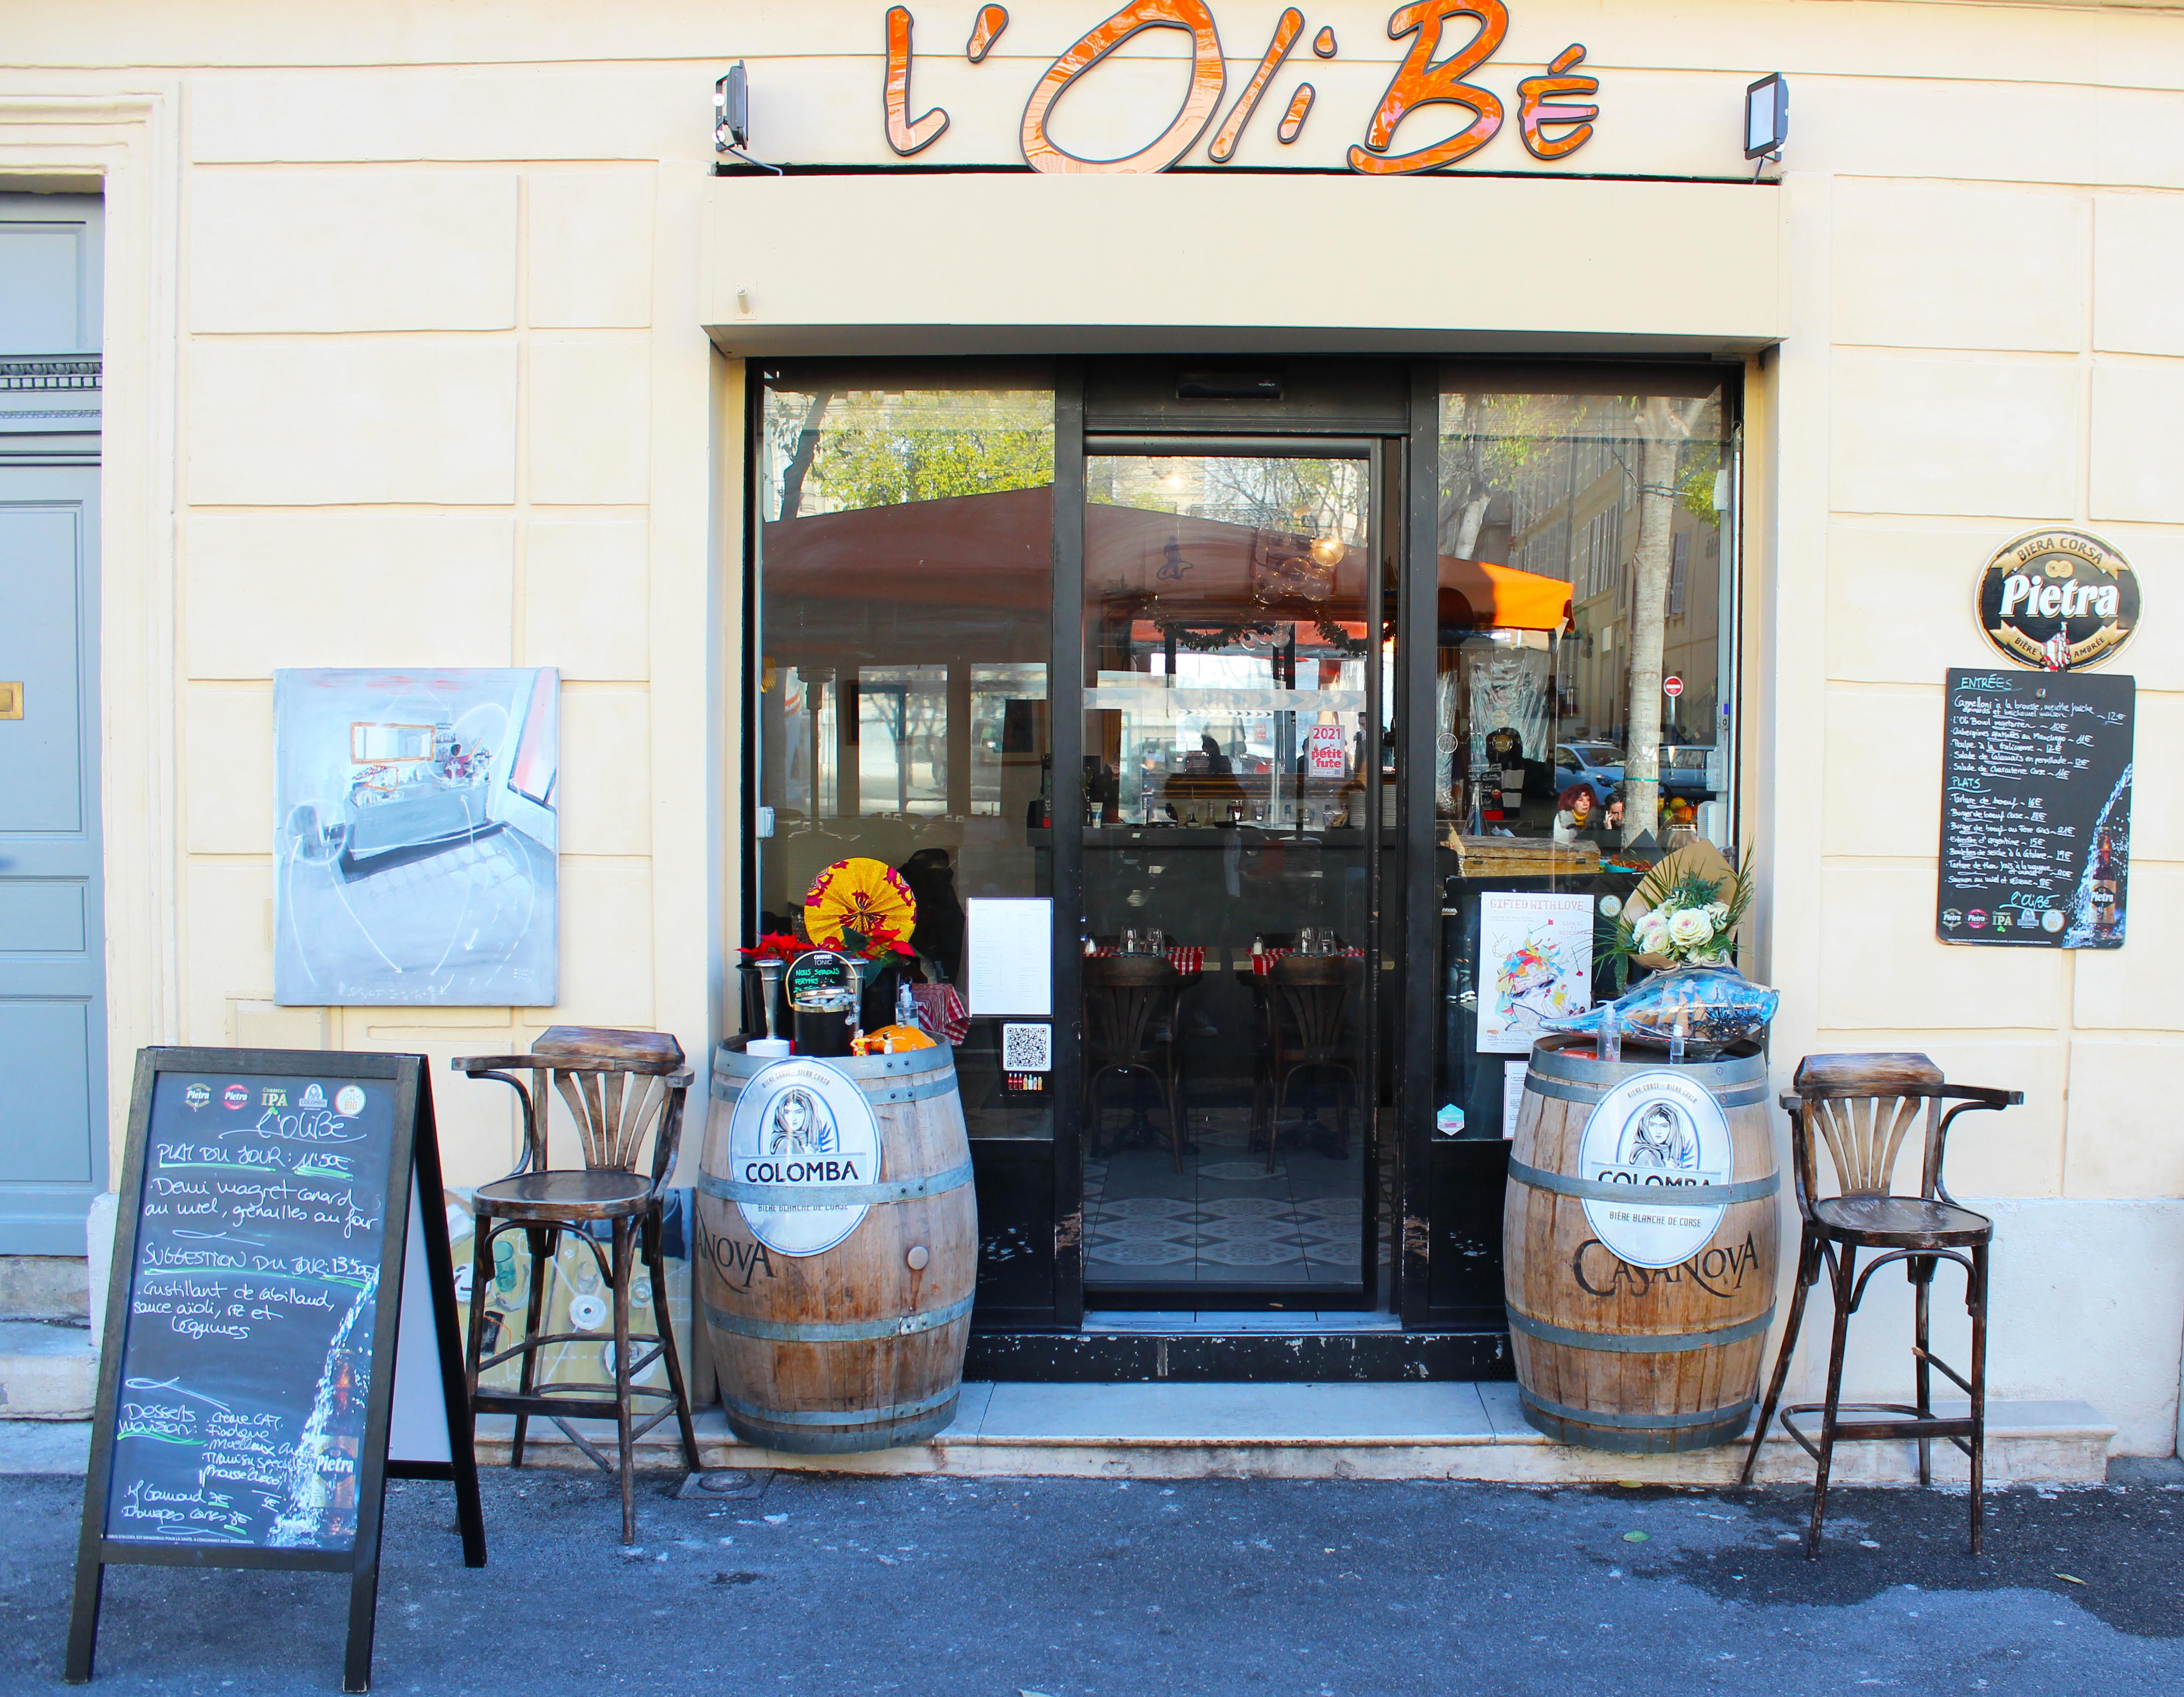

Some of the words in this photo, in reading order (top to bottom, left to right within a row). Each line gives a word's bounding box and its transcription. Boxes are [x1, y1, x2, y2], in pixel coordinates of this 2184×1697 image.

[2016, 537, 2055, 562] BIERA
[2060, 538, 2105, 565] CORSA
[1998, 574, 2121, 619] Pietra
[2014, 636, 2038, 656] BIÈRE
[2074, 636, 2106, 658] AMBRÉE
[1961, 673, 2013, 690] ENTRÉES
[1994, 698, 2002, 709] à
[2004, 698, 2013, 710] la
[1313, 727, 1341, 740] 2021
[2032, 732, 2066, 746] Manchego
[1952, 739, 1977, 751] Poulpe
[1311, 748, 1342, 760] petit
[1953, 751, 1976, 760] Salade
[1316, 758, 1341, 768] fute
[1953, 762, 1977, 772] Salade
[1952, 776, 1981, 789] PLATS
[1951, 793, 1977, 805] Tartare
[1979, 797, 1991, 805] de
[1950, 808, 1972, 820] Burger
[1950, 821, 1972, 832] Burger
[1948, 860, 1972, 869] Tartare
[1973, 862, 1982, 870] de
[1948, 875, 1972, 884] Saumon
[1985, 874, 2000, 884] miel
[2000, 876, 2008, 885] et
[2091, 891, 2114, 903] Pietra
[1490, 898, 1528, 909] GIFTED
[1531, 899, 1556, 909] WITH
[1557, 900, 1584, 910] LOVE
[1943, 913, 1961, 922] Pietra
[1967, 915, 1985, 923] Pietra
[1992, 916, 2014, 926] IPA
[2048, 921, 2058, 929] BIO
[814, 967, 840, 976] SERONS
[794, 975, 819, 985] FERMÉS
[814, 1073, 831, 1086] CORSA
[187, 1090, 210, 1100] Pietra
[224, 1091, 248, 1101] Pietra
[1643, 1082, 1660, 1091] CORSE
[1682, 1090, 1698, 1103] CORSA
[261, 1093, 289, 1107] IPA
[344, 1101, 358, 1111] BIO
[157, 1143, 195, 1162] PLAT
[199, 1147, 230, 1162] DU
[745, 1160, 860, 1184] COLOMBA
[153, 1178, 210, 1196] Demi
[217, 1179, 297, 1208] magret
[297, 1188, 364, 1211] canard
[145, 1202, 169, 1217] au
[314, 1211, 341, 1224] au
[344, 1208, 379, 1239] four
[1609, 1210, 1630, 1221] BIÈRE
[1632, 1213, 1666, 1225] BLANCHE
[1668, 1216, 1677, 1226] DE
[1679, 1217, 1701, 1228] CORSE
[143, 1242, 247, 1268] SUGGESTION
[252, 1254, 288, 1270] DU
[234, 1283, 254, 1301] de
[133, 1301, 172, 1315] sauce
[251, 1304, 285, 1321] et
[123, 1403, 197, 1422] Desserts
[316, 1455, 355, 1474] Pietra
